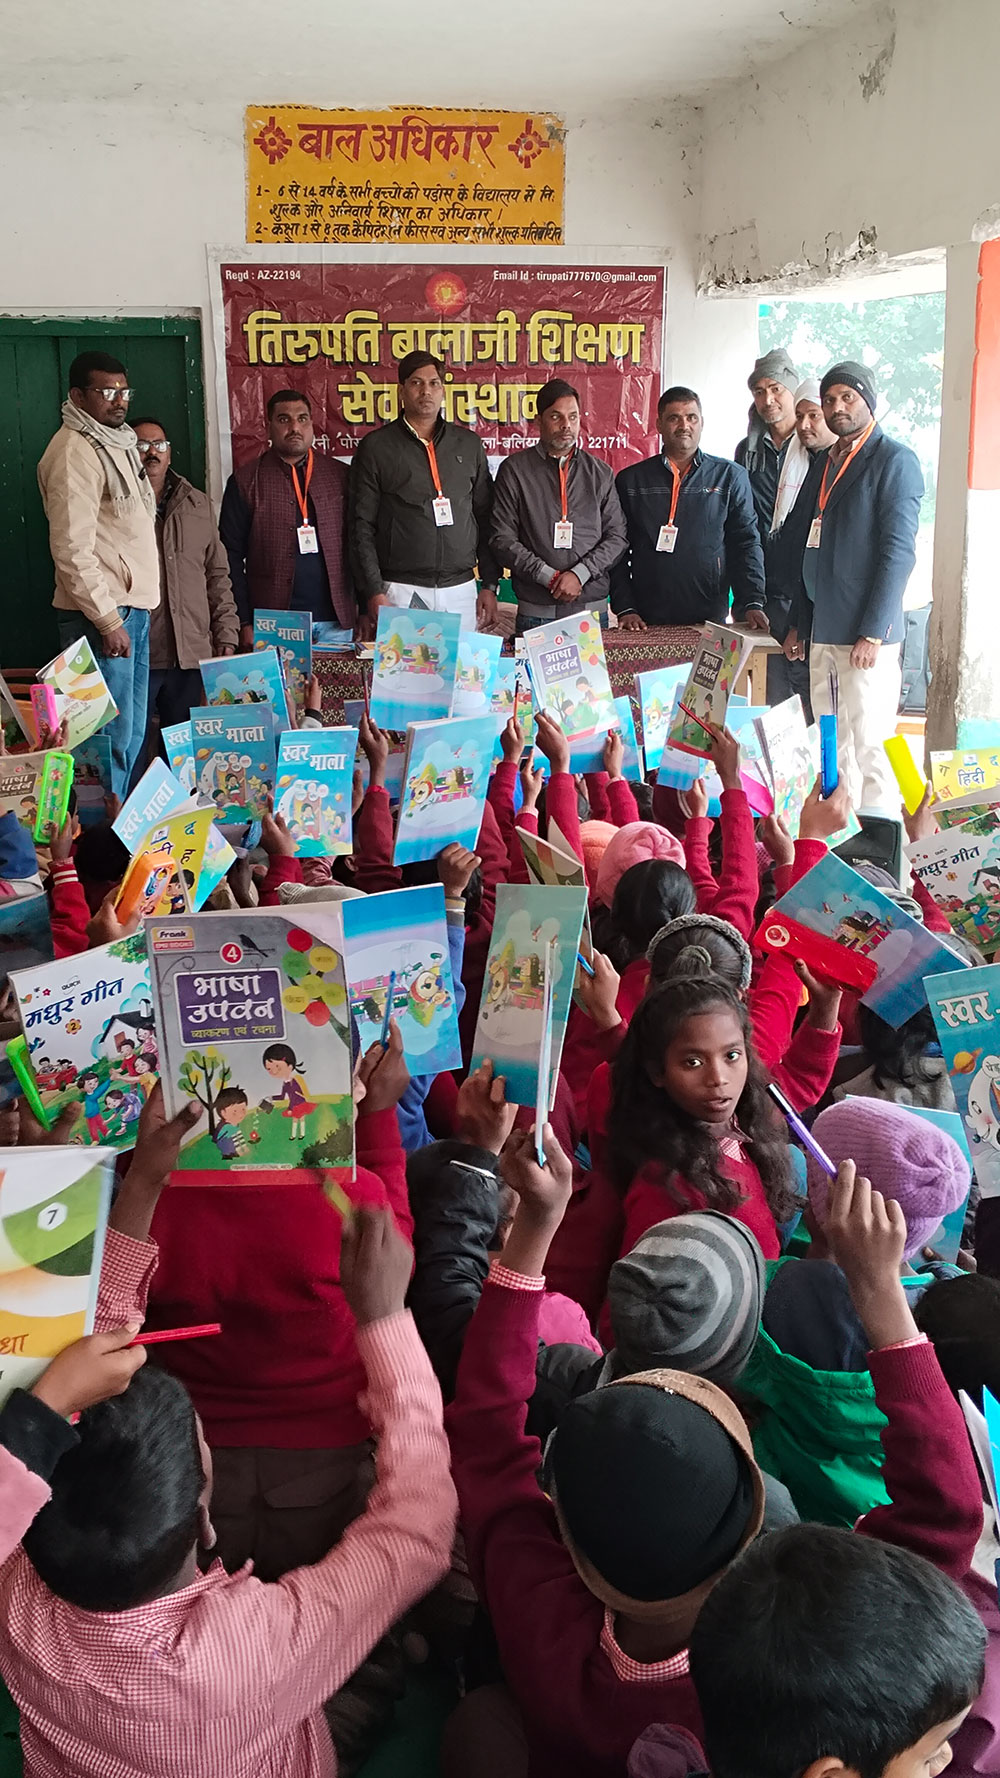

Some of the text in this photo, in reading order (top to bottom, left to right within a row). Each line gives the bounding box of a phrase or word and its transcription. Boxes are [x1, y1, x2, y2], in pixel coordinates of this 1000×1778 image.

[297, 114, 500, 169] बाल अधिकार
[278, 185, 285, 197] 6
[288, 181, 301, 201] से
[303, 185, 317, 198] 14
[318, 176, 336, 198] वर्ष
[335, 181, 348, 198] के
[349, 179, 373, 201] सभी
[402, 181, 420, 200] को
[457, 183, 469, 201] के
[472, 182, 521, 207] विद्यालय
[523, 184, 536, 202] में
[269, 203, 301, 222] शुल्क
[377, 200, 413, 224] शिक्षा
[415, 206, 433, 221] का
[438, 202, 493, 225] अधिकार
[271, 222, 301, 240] कक्षा
[302, 223, 308, 235] 1
[309, 219, 322, 240] से
[323, 223, 330, 235] 8
[332, 223, 351, 241] तक
[404, 220, 430, 241] फीस
[448, 225, 471, 241] अन्य
[496, 225, 521, 244] शुल्क
[225, 269, 249, 282] Regd
[257, 269, 301, 280] AZ-22194
[493, 270, 518, 281] Email
[520, 270, 528, 281] Id
[536, 271, 657, 283] tirupati777670@gmail.com
[243, 309, 645, 364] तिरुपति बालाजी शिक्षण
[338, 371, 399, 423] सेव
[588, 436, 627, 449] 221711
[256, 618, 305, 641] स्वर माला
[544, 656, 578, 675] उपवन
[545, 648, 572, 663] भाषा
[166, 727, 191, 746] स्वर
[195, 718, 265, 743] स्वर माला
[282, 744, 348, 771] स्वर माला
[957, 767, 985, 786] हिंदी
[119, 779, 176, 841] स्वर माला
[914, 845, 980, 878] मधुर गीत
[226, 946, 238, 960] 4
[193, 974, 262, 998] भाषा
[24, 977, 124, 1028] मधुर गीत
[185, 997, 275, 1024] उपवन
[937, 991, 994, 1028] स्वर
[70, 1022, 77, 1031] 2
[191, 1024, 276, 1038] व्याकरण एवं रचना
[47, 1209, 58, 1226] 7
